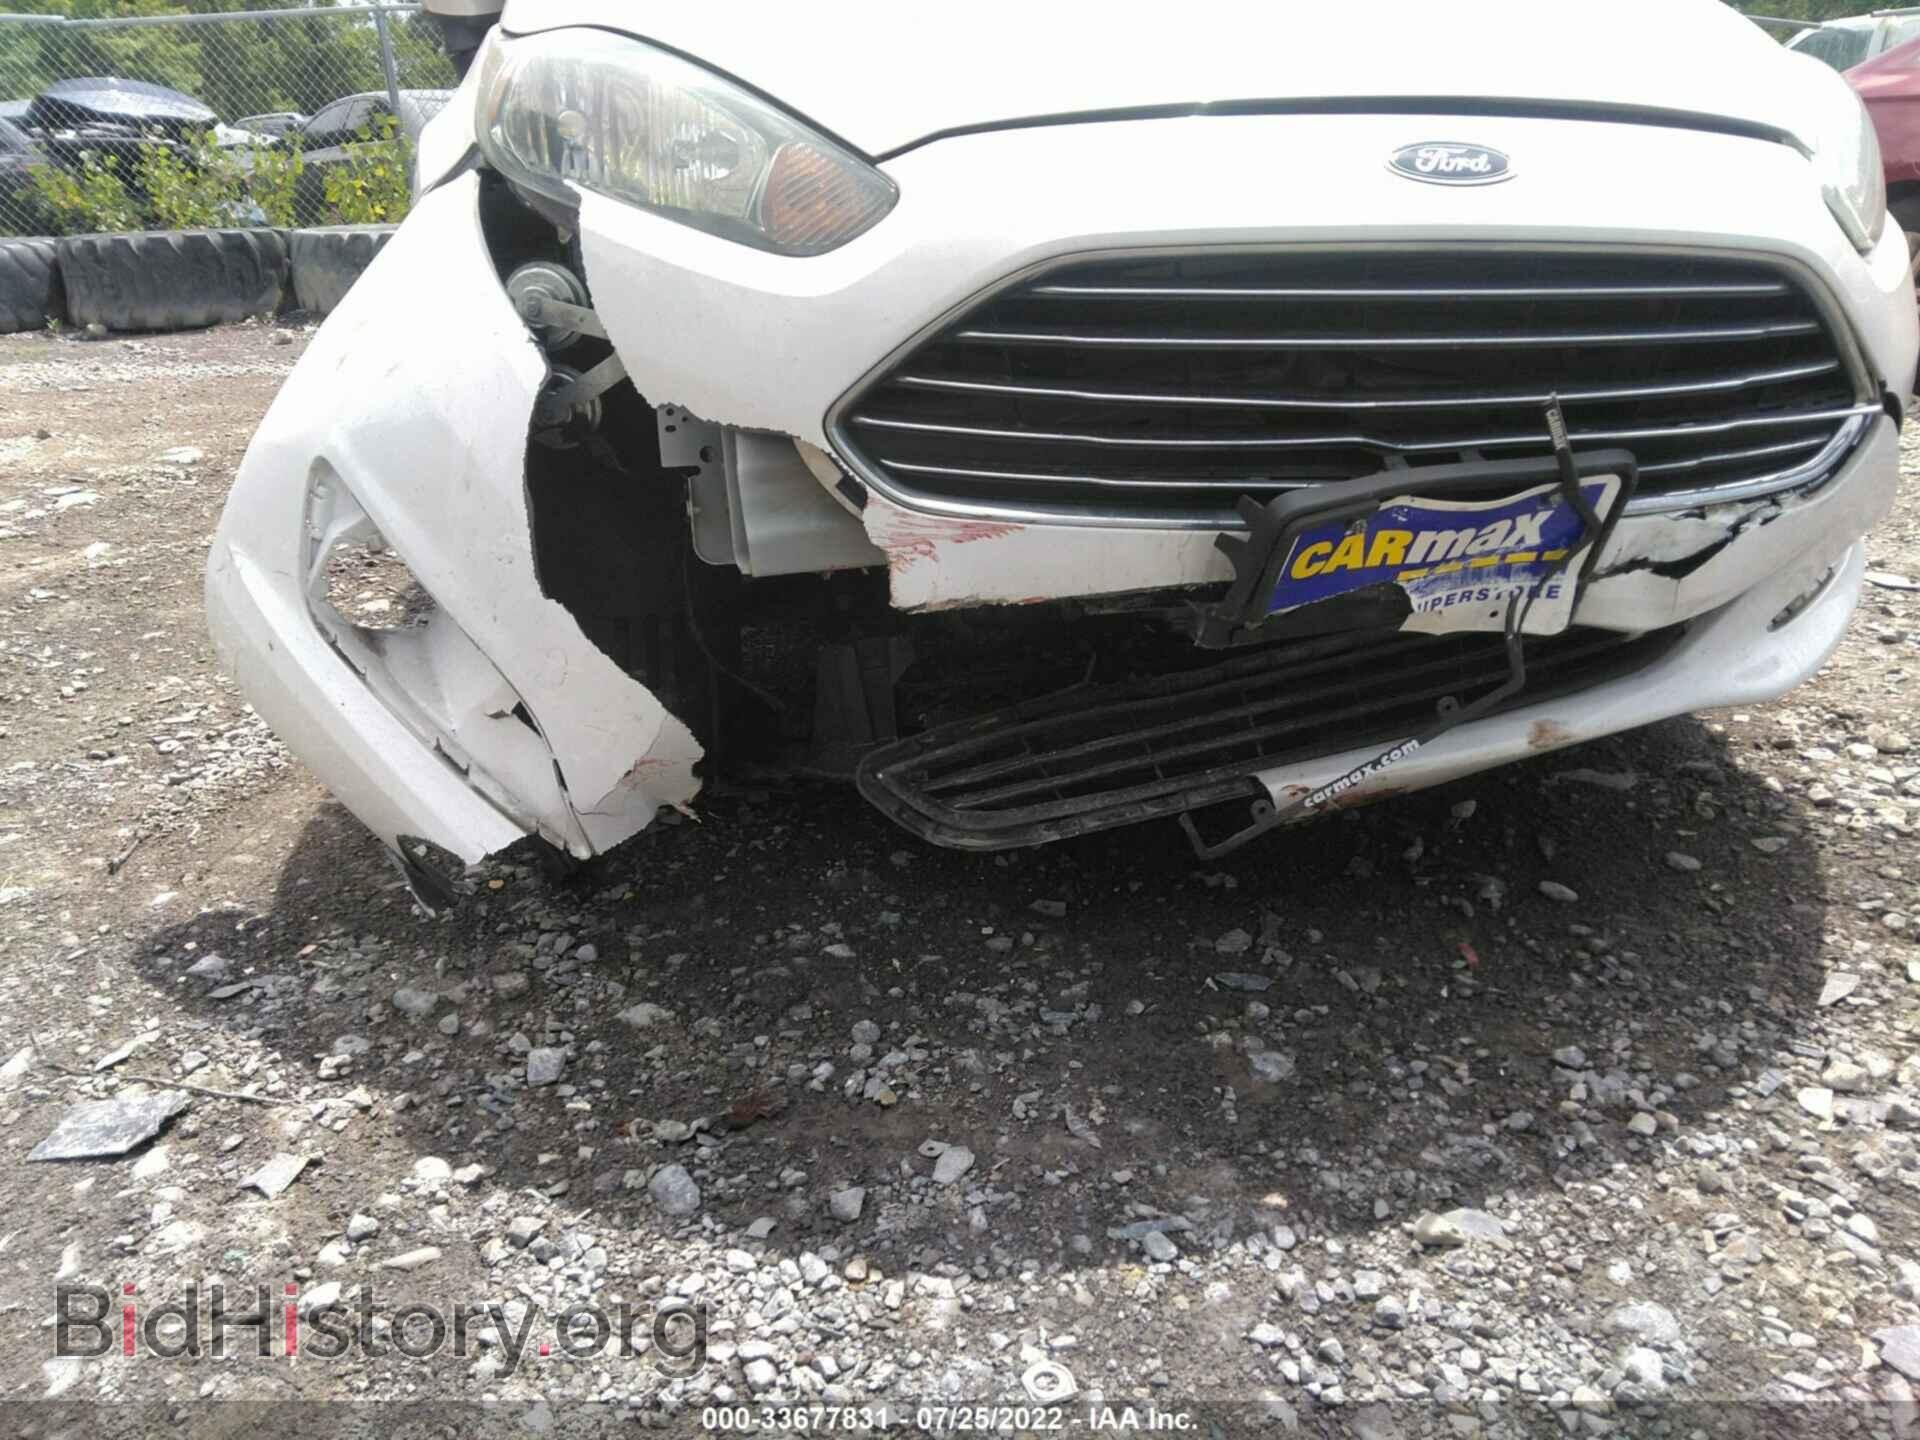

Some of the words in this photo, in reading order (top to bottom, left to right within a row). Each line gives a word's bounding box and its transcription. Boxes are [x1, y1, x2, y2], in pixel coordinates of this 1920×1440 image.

[1415, 147, 1492, 172] Ford
[1290, 510, 1554, 580] CARmax
[1303, 739, 1420, 808] carmax.com
